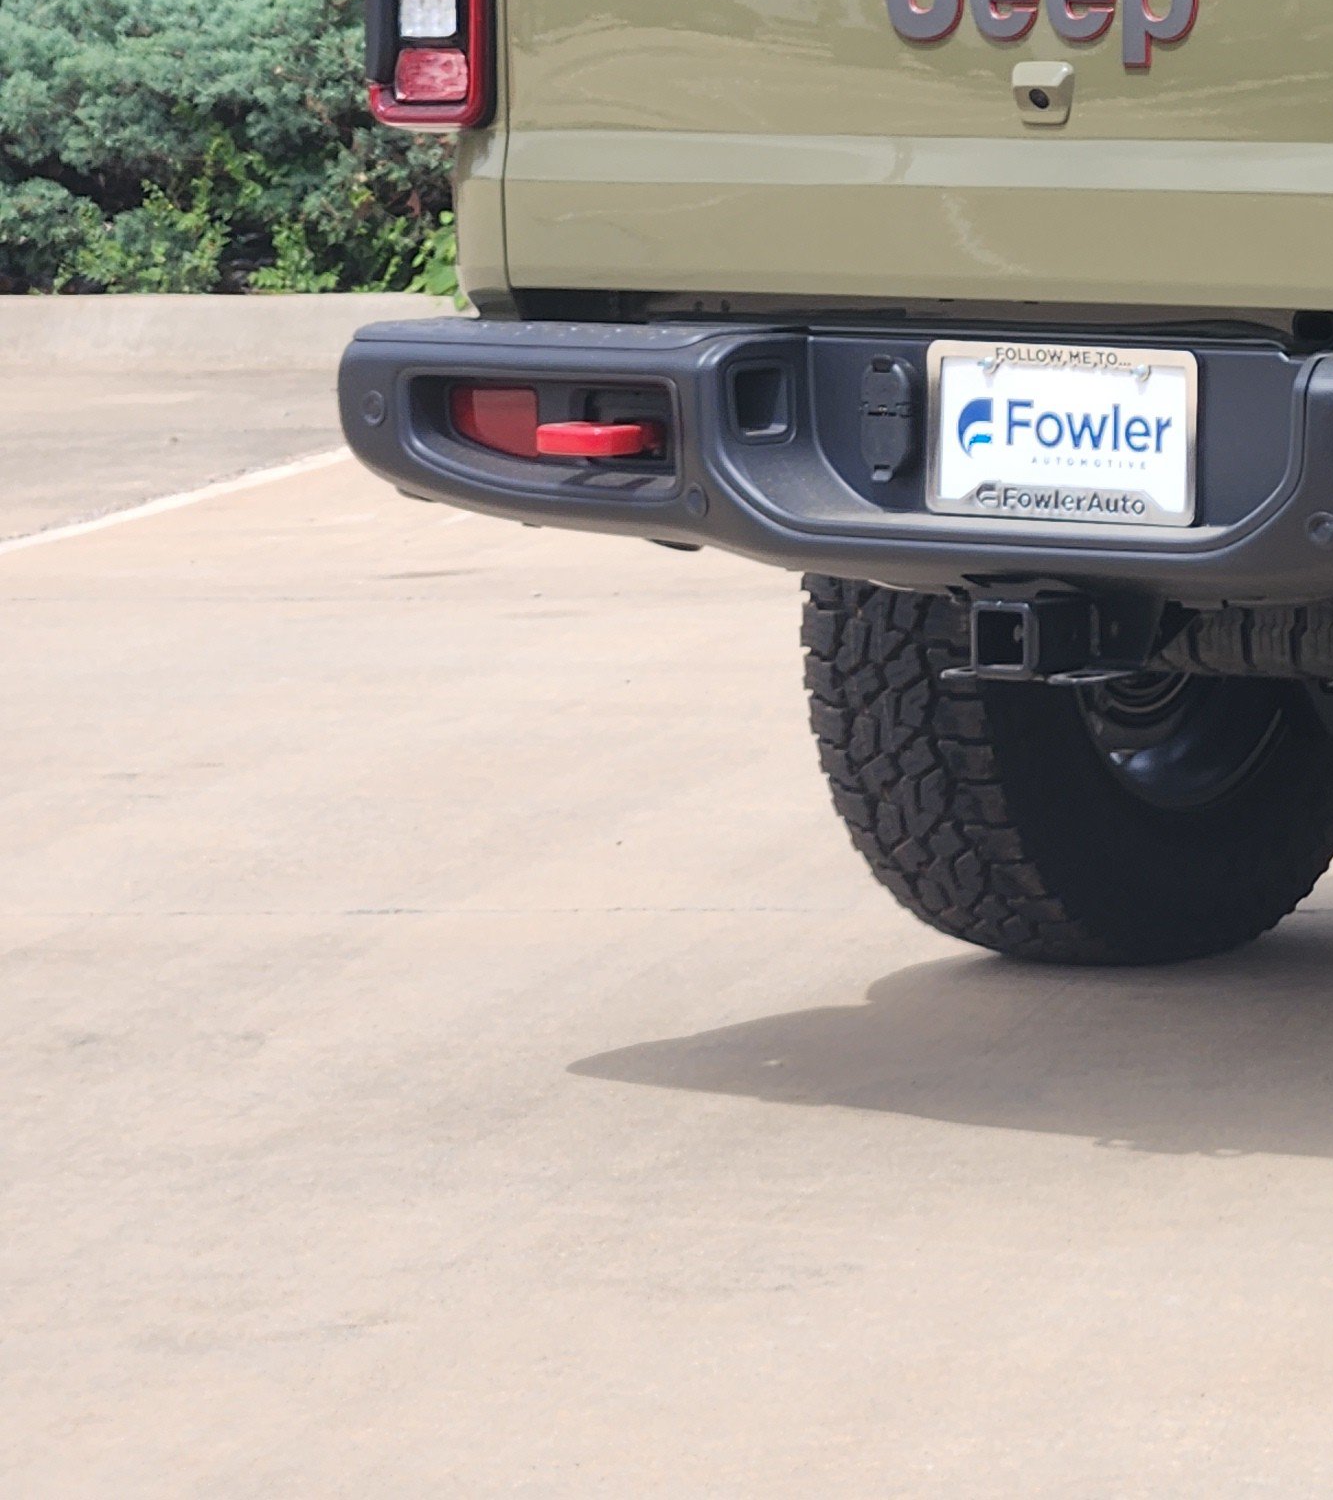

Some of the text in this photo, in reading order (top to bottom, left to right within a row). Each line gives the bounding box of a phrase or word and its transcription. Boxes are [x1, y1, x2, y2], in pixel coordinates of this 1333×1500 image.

[995, 346, 1063, 363] FOLLOW
[1069, 351, 1092, 365] ME
[1006, 398, 1172, 453] Fowler
[1031, 456, 1147, 470] AUTOMOTIVE
[1002, 487, 1146, 515] FowlerAuto
